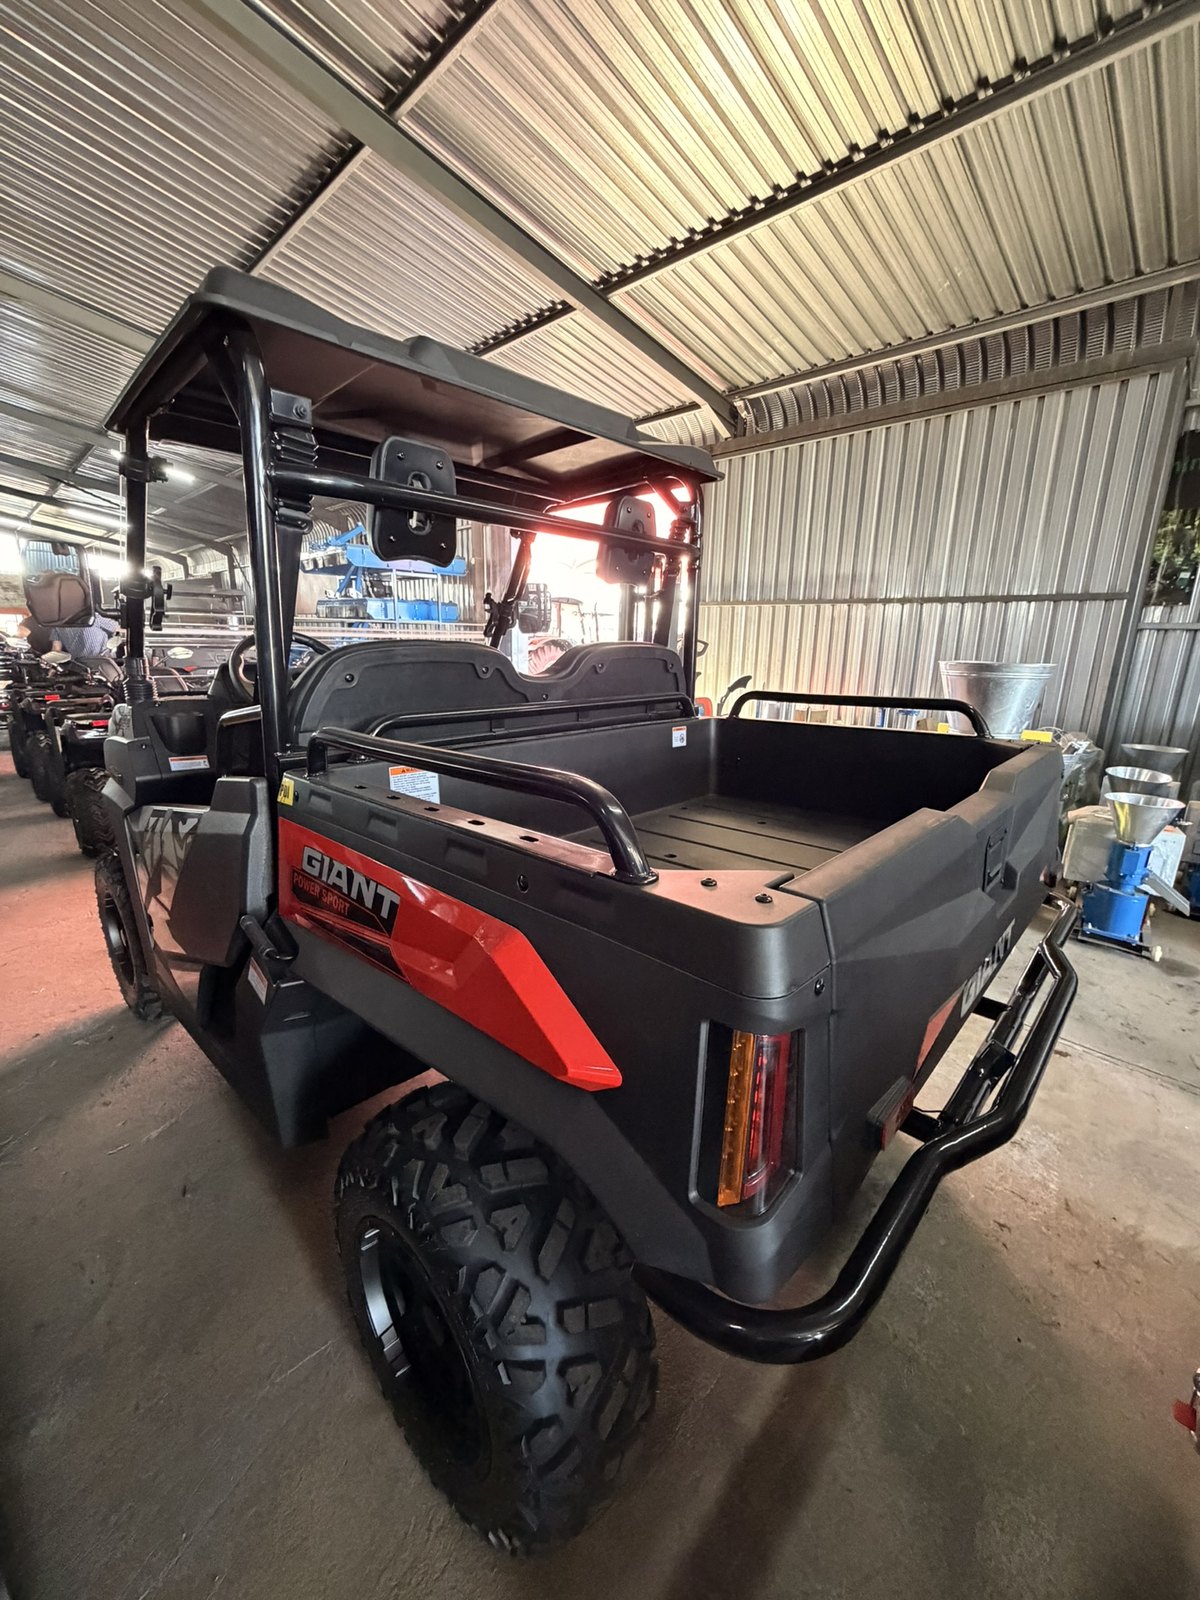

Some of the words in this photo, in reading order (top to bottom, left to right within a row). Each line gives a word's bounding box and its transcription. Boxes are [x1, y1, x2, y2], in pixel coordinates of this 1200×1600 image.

[293, 871, 320, 898] POWER
[321, 888, 350, 915] SPORT
[302, 846, 400, 919] GIANT
